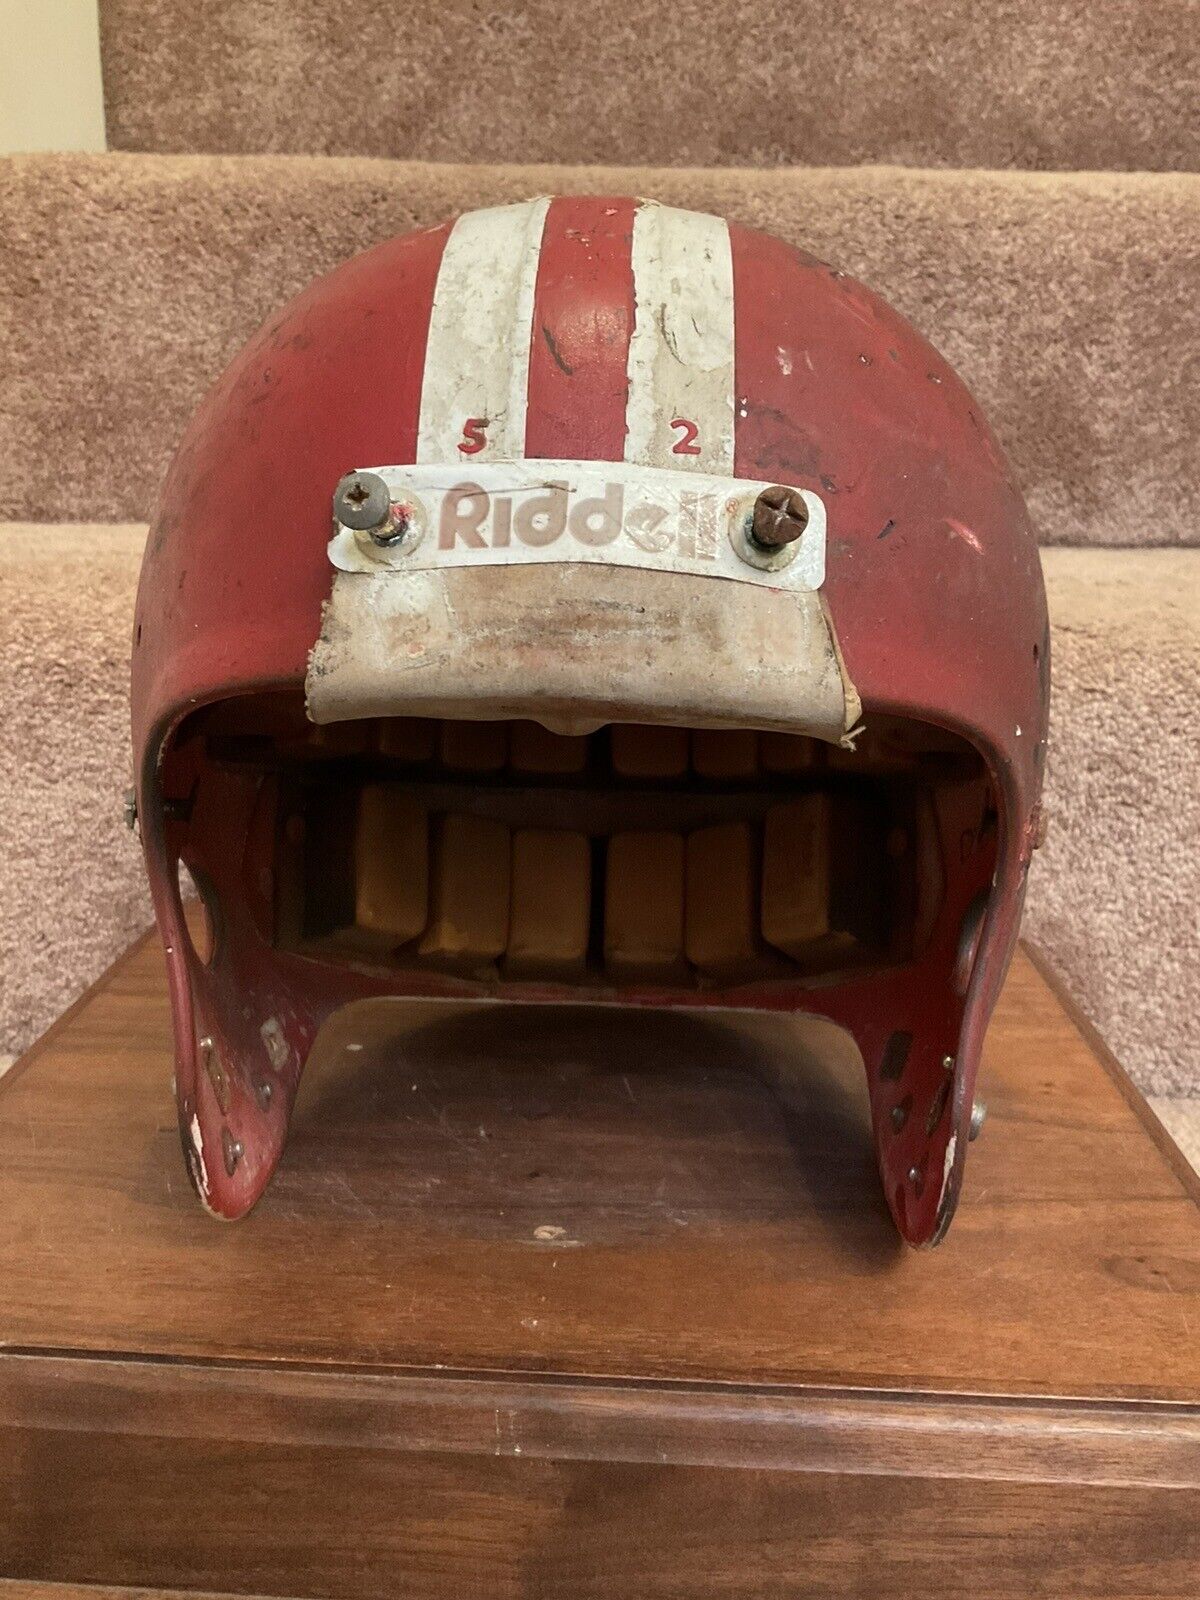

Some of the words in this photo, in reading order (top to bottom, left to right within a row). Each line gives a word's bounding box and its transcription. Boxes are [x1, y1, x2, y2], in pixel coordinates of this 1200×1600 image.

[458, 418, 488, 454] 5
[670, 420, 701, 455] 2
[438, 480, 718, 560] Riddell
